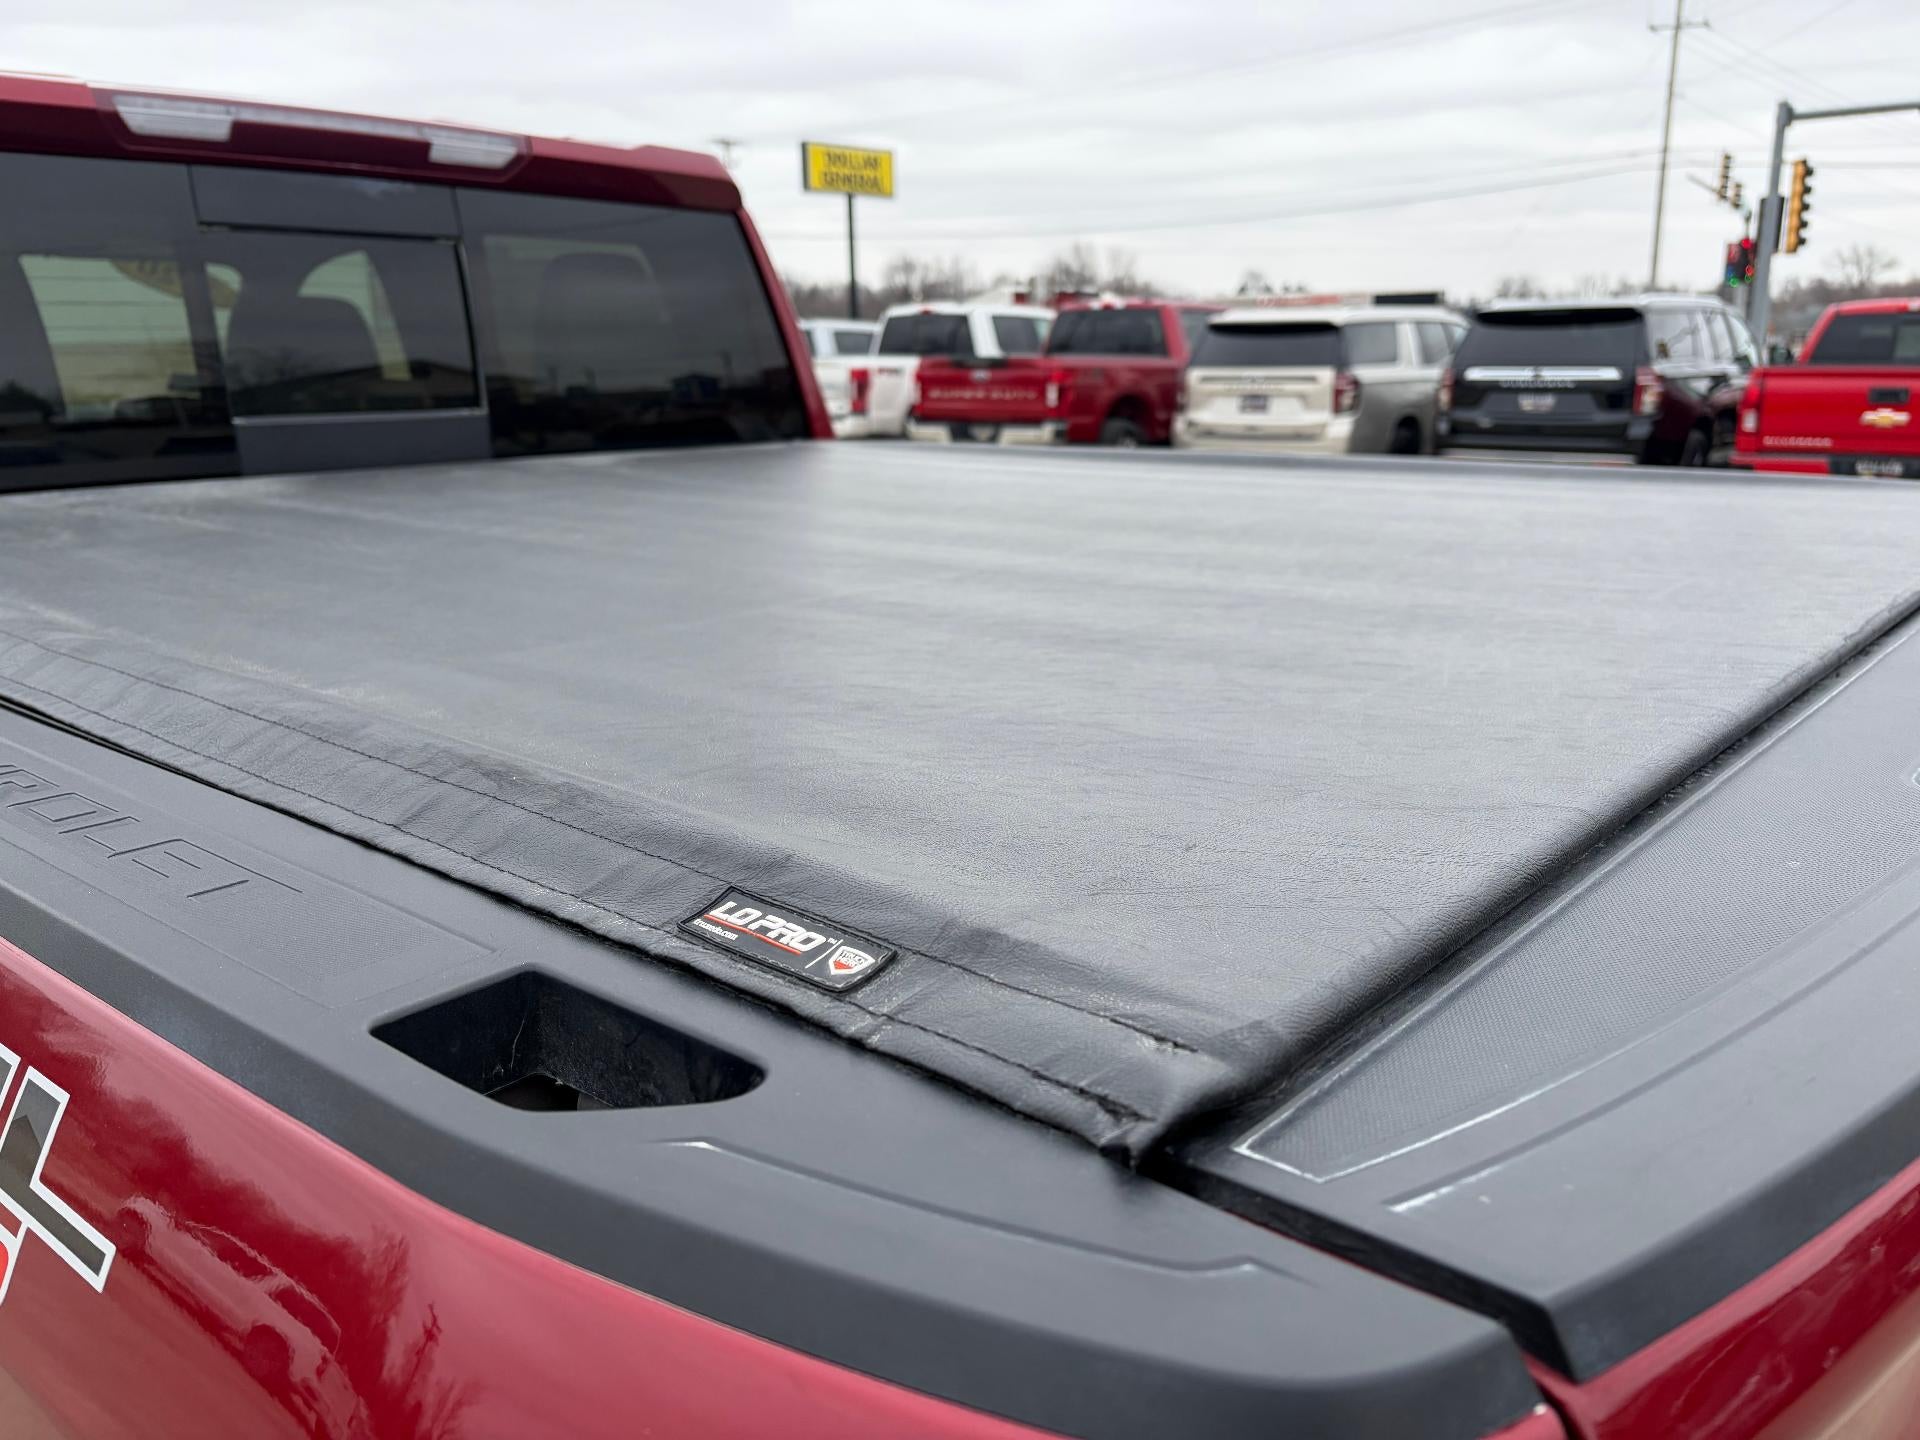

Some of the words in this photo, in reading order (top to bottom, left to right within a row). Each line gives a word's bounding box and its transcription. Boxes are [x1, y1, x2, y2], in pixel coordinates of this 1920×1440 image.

[0, 764, 303, 898] ROLET
[709, 901, 762, 926] LO
[747, 915, 827, 952] PRO
